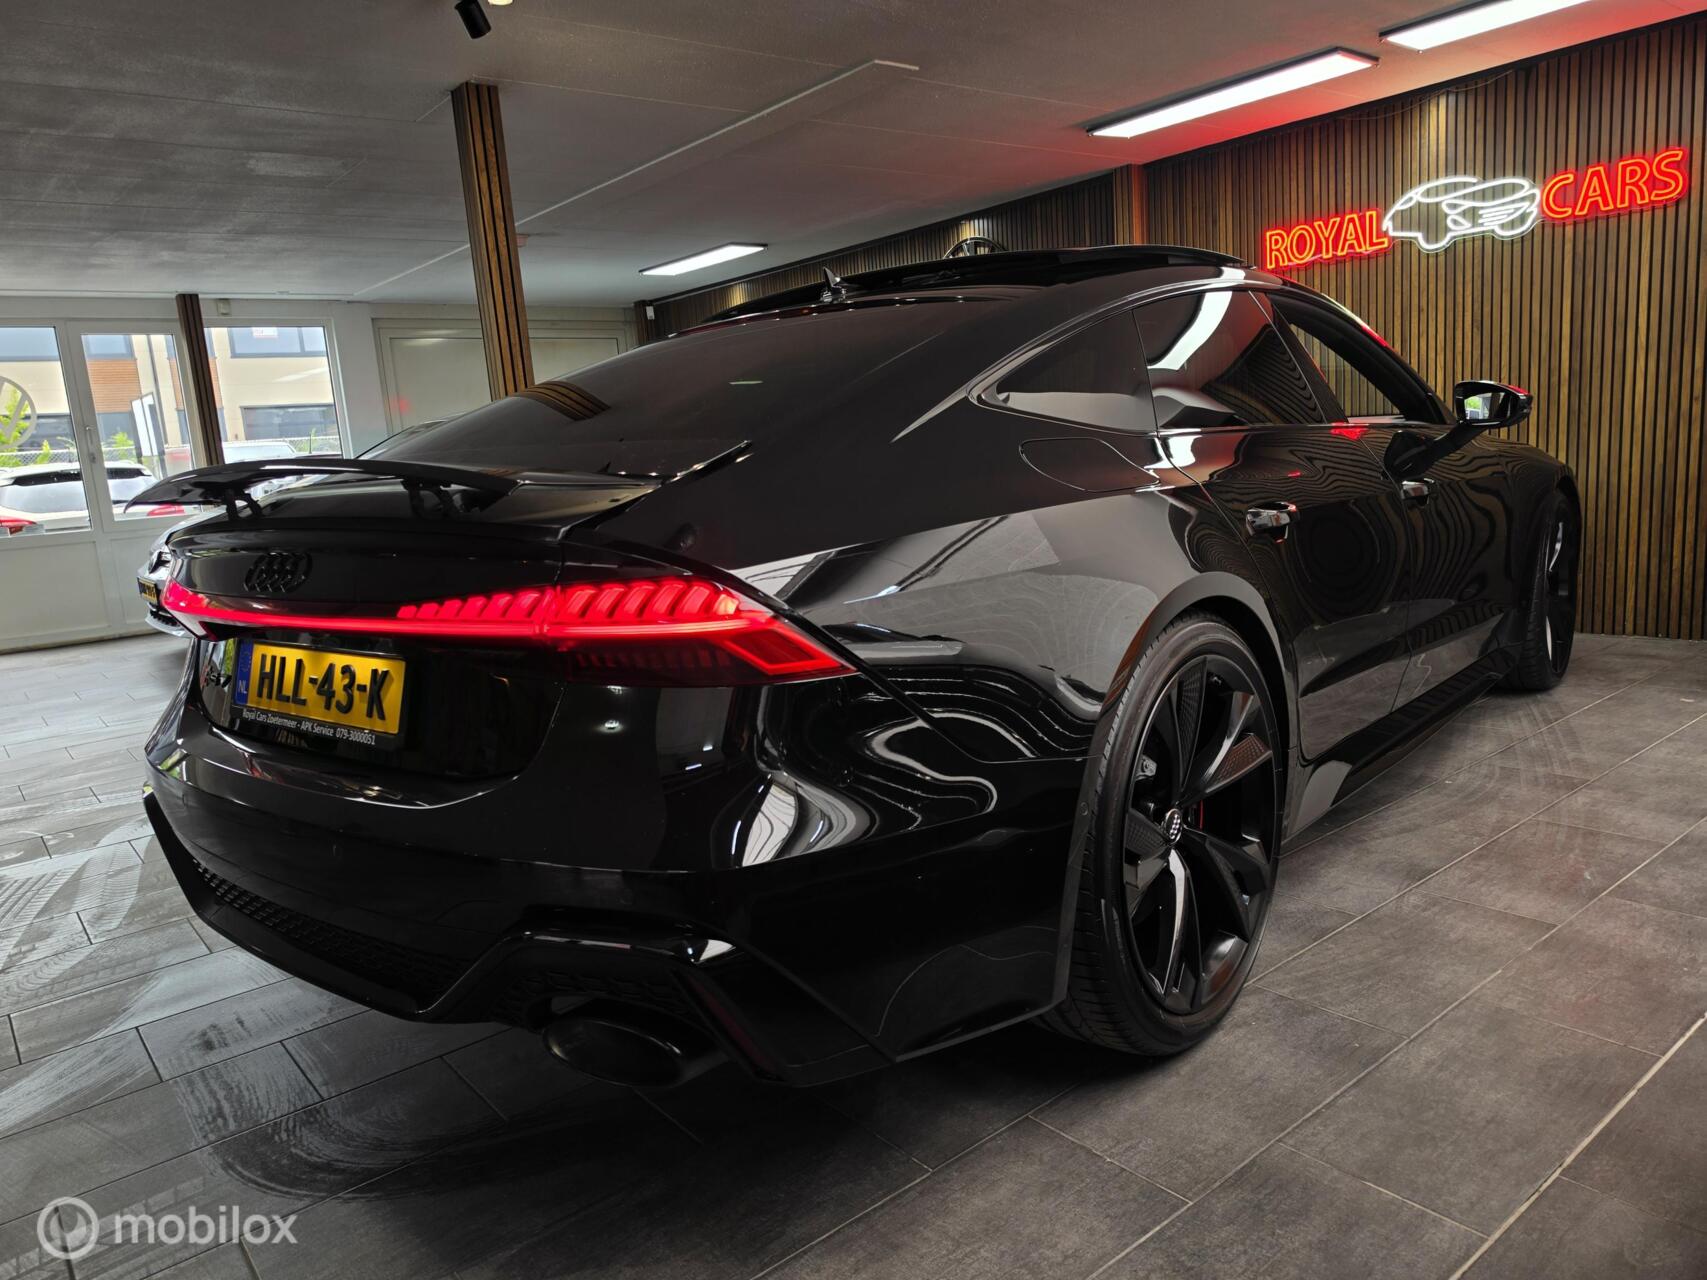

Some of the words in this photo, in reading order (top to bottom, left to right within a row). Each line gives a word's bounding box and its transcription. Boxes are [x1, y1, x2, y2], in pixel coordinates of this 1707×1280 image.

[1265, 210, 1388, 270] ROYAL
[1542, 149, 1684, 219] CARS
[256, 652, 390, 721] HLL-43-K
[242, 708, 255, 720] Royal
[256, 711, 267, 722] Cars
[300, 720, 313, 732] APK
[313, 723, 334, 736] Service
